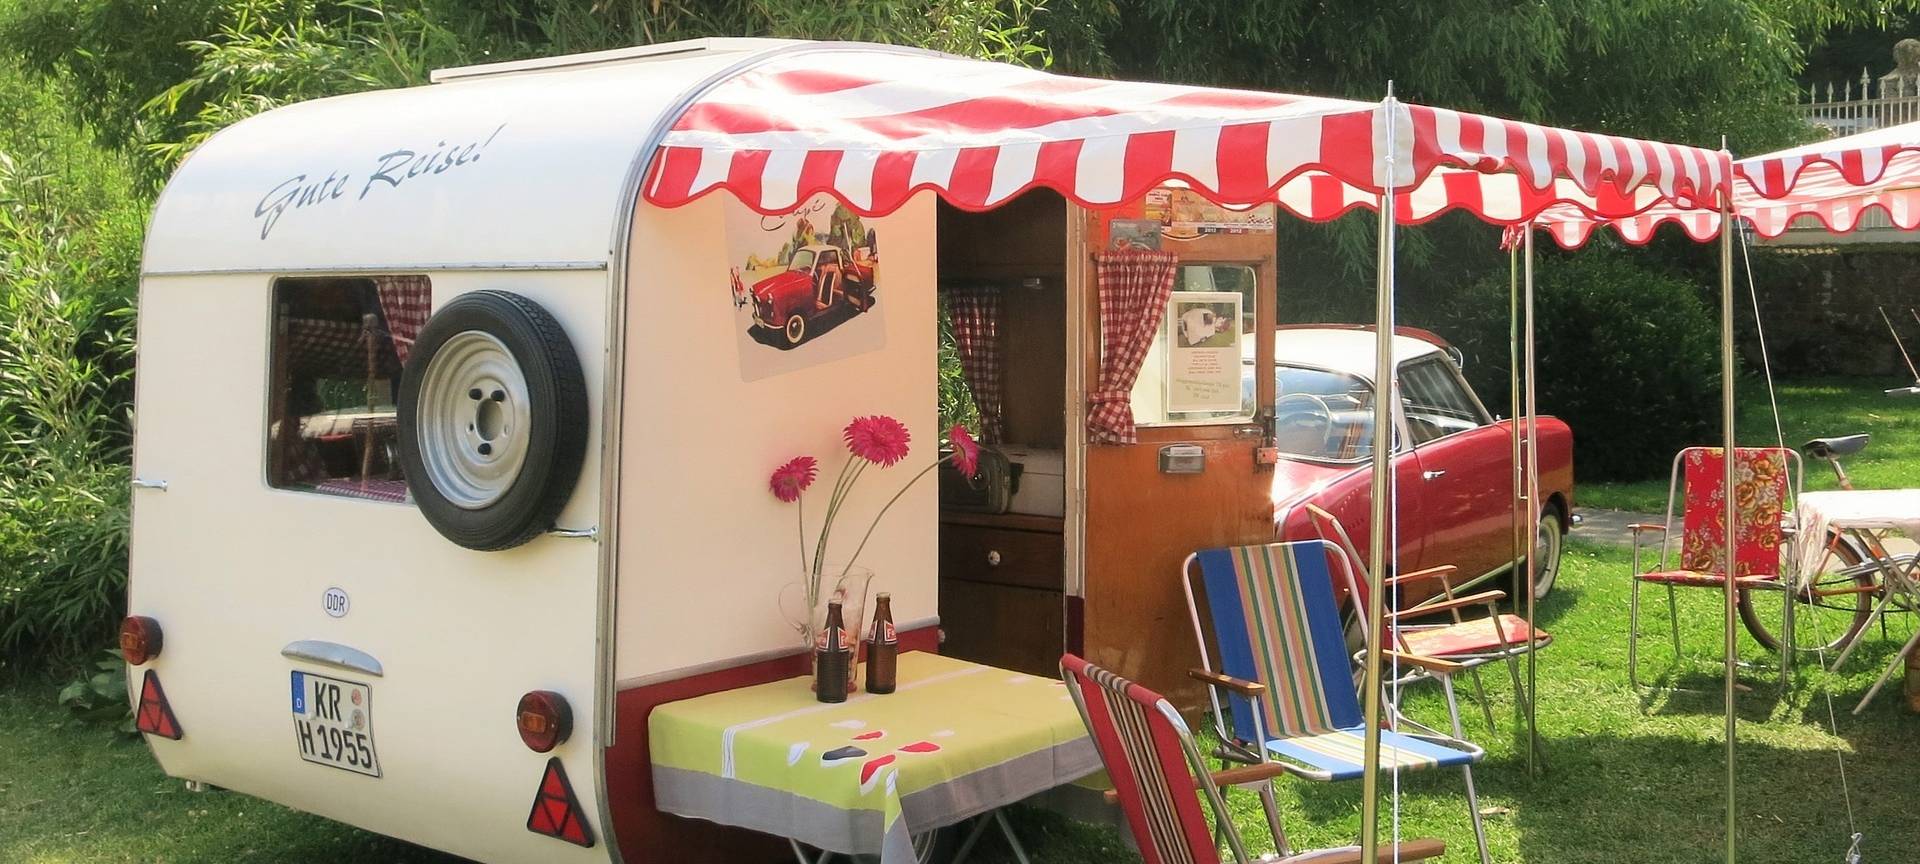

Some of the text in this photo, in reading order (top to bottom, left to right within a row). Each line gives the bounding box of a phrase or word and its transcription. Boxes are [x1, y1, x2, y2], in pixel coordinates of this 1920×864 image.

[254, 123, 508, 240] Gute Reise!
[761, 199, 826, 231] Cupé
[326, 593, 346, 613] DDR
[315, 681, 342, 722] KR
